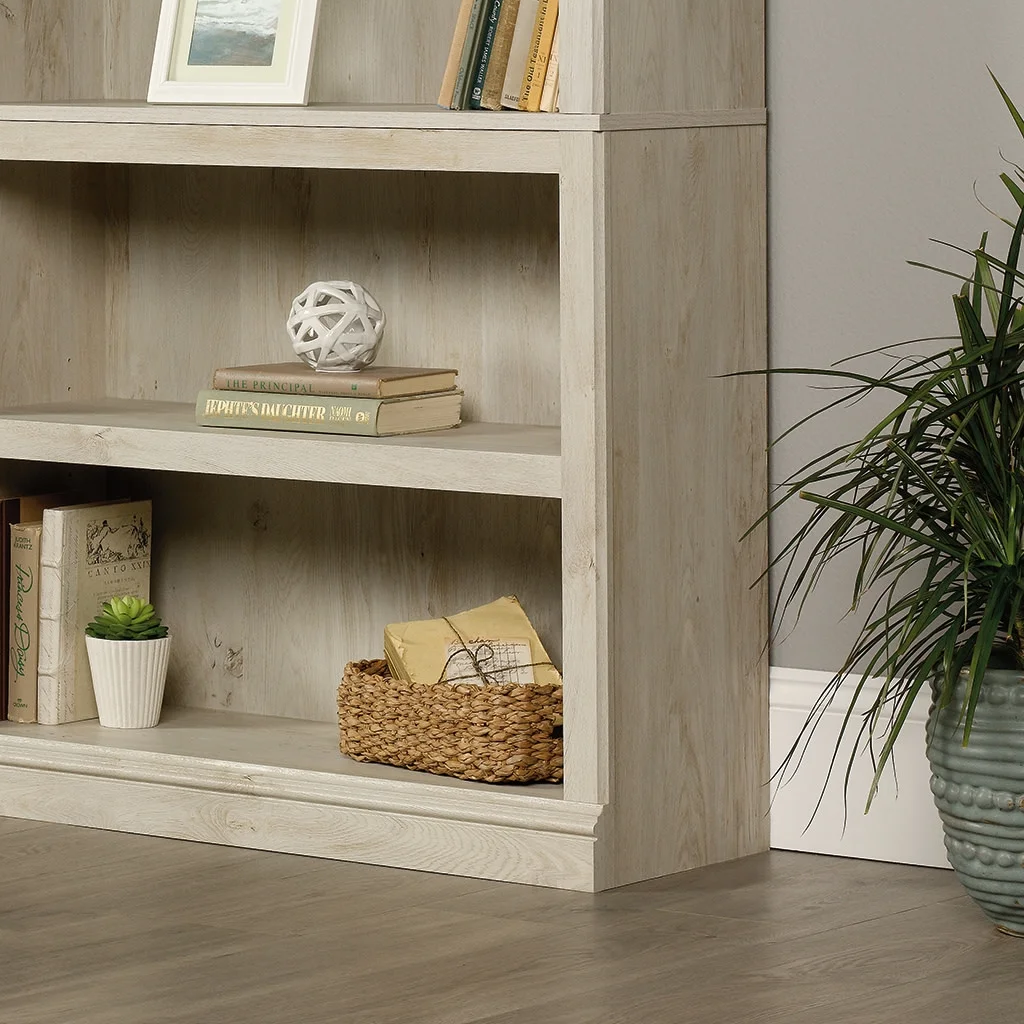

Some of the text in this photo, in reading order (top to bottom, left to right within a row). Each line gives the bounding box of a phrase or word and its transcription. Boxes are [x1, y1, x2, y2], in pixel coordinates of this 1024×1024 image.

[485, 25, 494, 46] ROBERT
[530, 16, 545, 64] Testament
[481, 46, 489, 62] JAMES
[476, 62, 485, 84] WALLER
[525, 66, 535, 82] Old
[521, 84, 531, 102] The
[226, 380, 316, 393] THE PRINCIPAL
[204, 399, 326, 420] JEPHTE'S DAUGHTER
[328, 406, 352, 416] NAOMI
[13, 542, 32, 550] KRANTZ
[14, 536, 32, 544] JUDITH
[88, 564, 126, 577] CANTO
